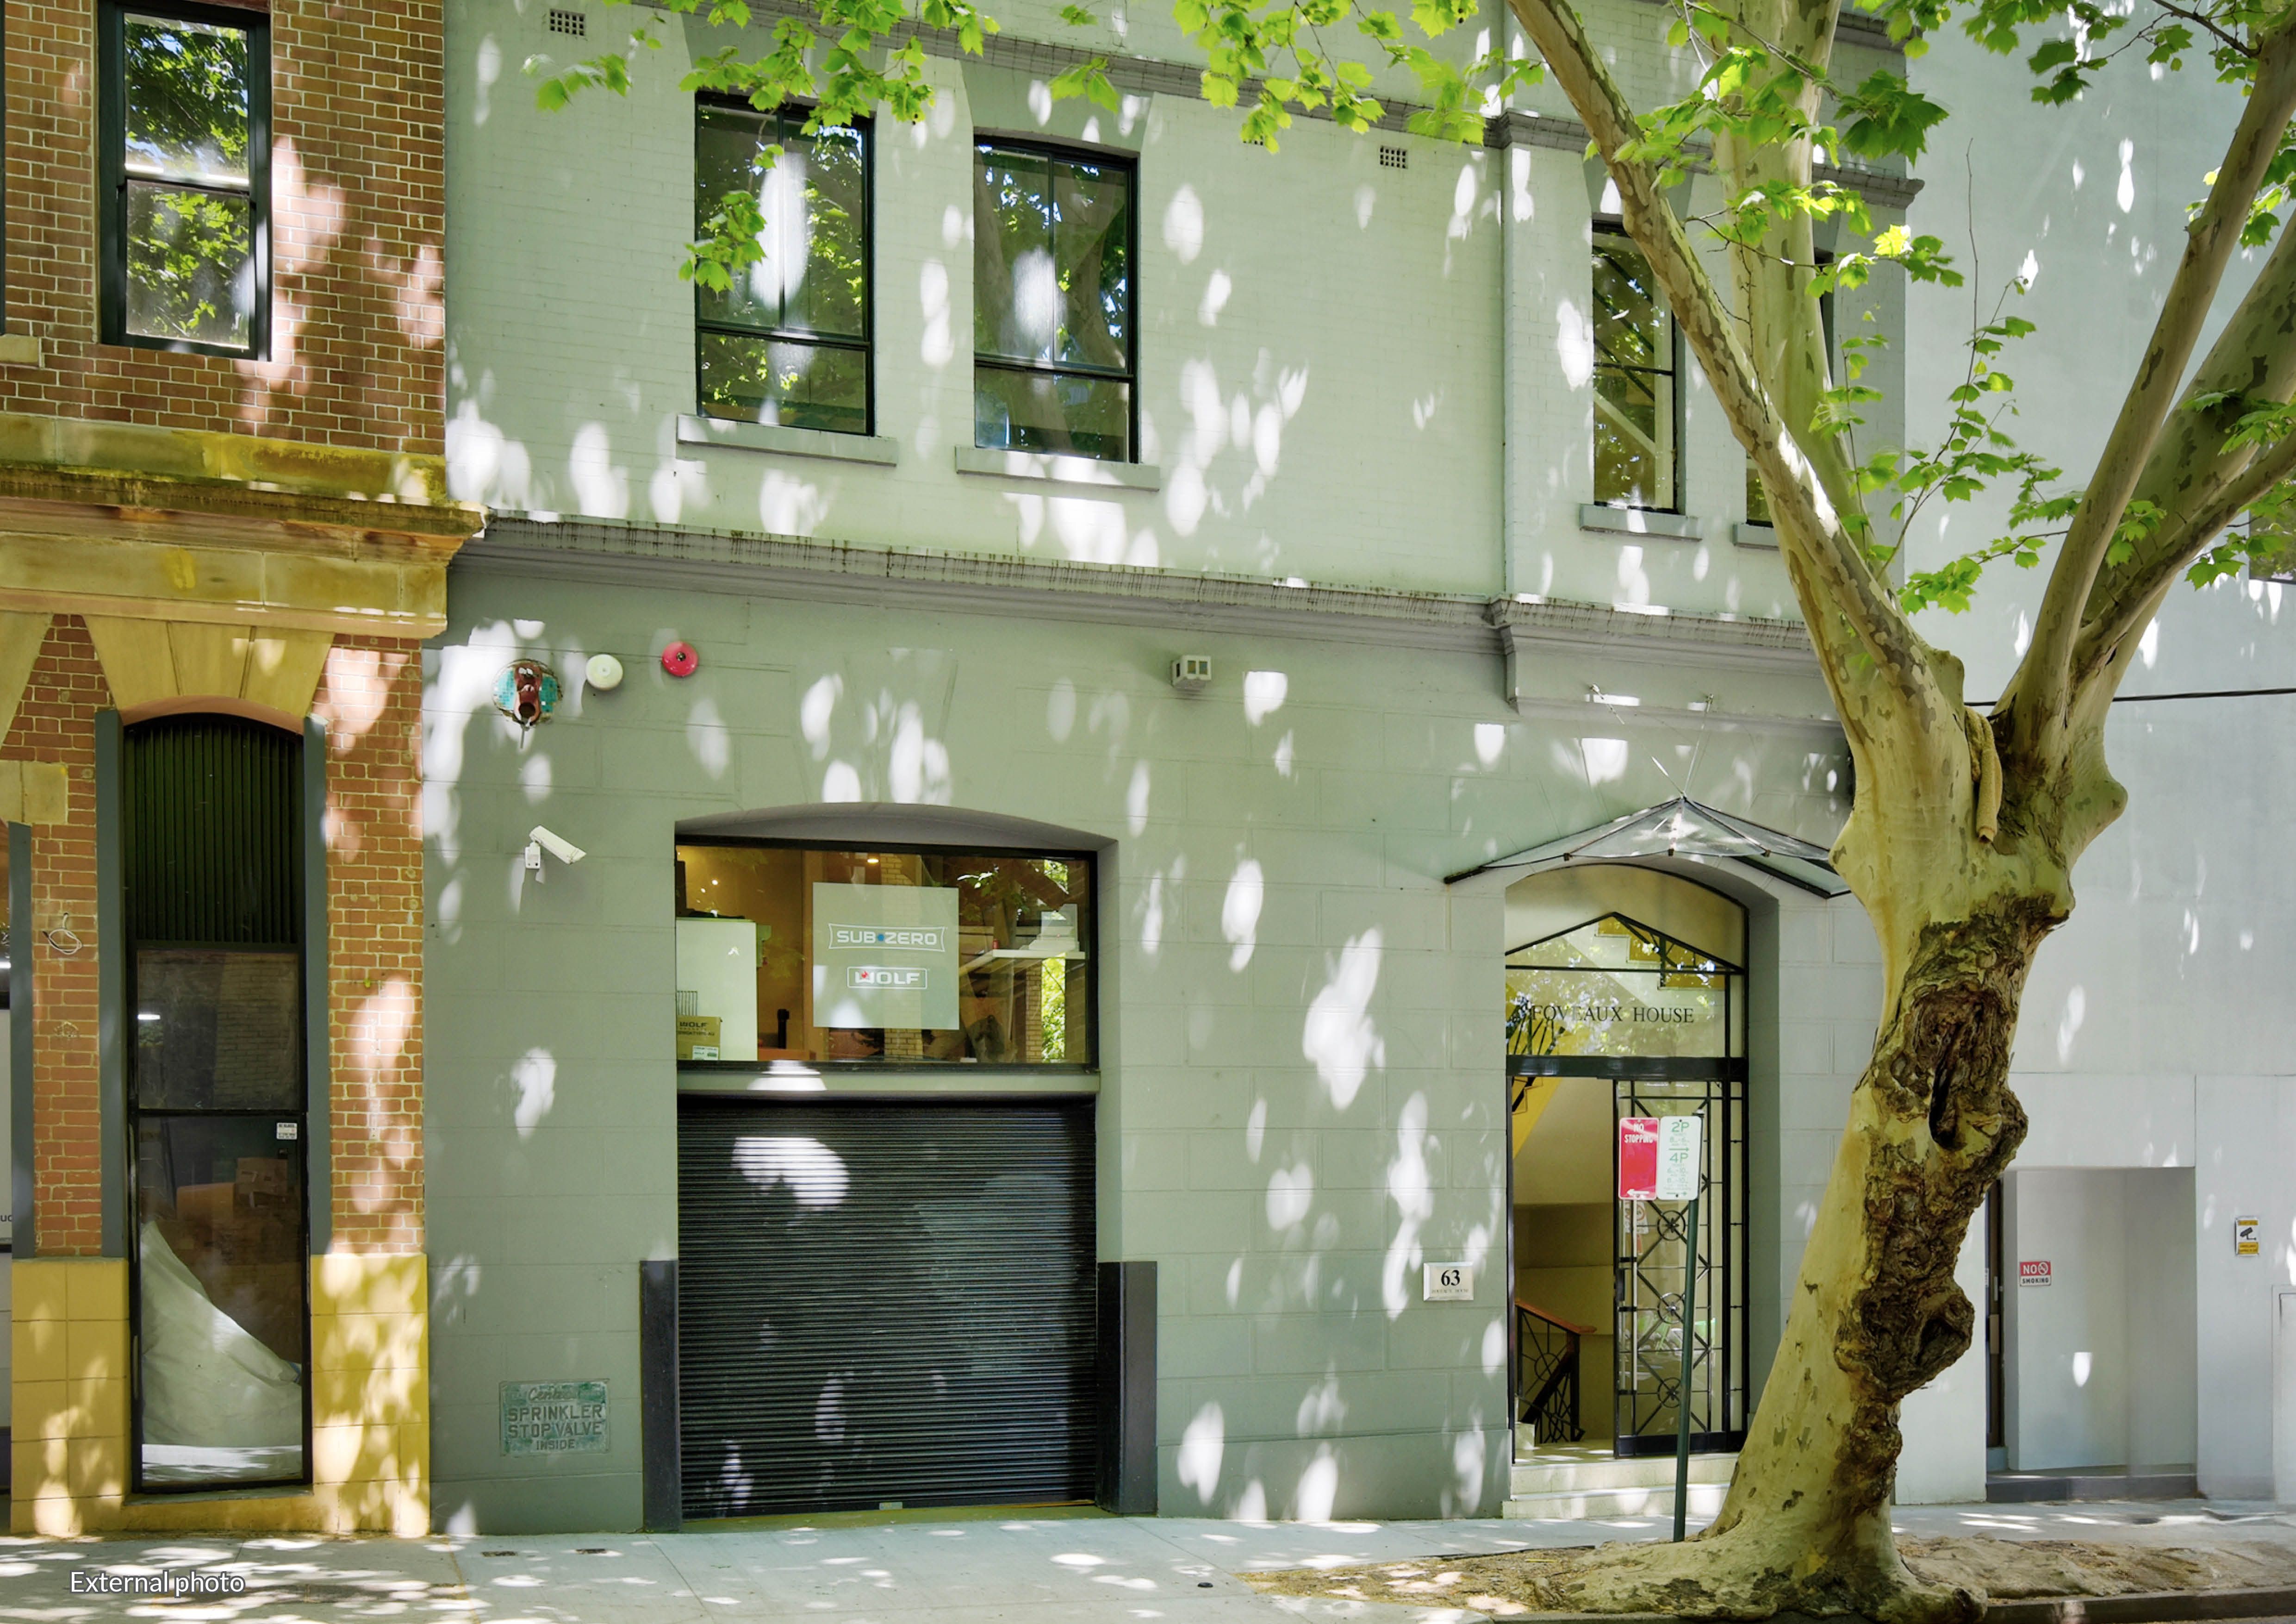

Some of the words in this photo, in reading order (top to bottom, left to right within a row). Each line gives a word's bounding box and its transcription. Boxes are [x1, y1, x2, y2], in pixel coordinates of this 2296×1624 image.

[855, 971, 920, 985] WOLF
[1633, 1007, 1694, 1023] HOUSE
[1633, 1123, 1644, 1132] NO
[1671, 1122, 1689, 1132] 2P
[1624, 1134, 1654, 1143] STOPPING
[1669, 1152, 1689, 1163] 4P
[2023, 1264, 2037, 1274] NO
[1441, 1270, 1460, 1286] 63
[508, 1404, 602, 1422] SPRINKLER
[508, 1424, 551, 1438] STOP
[556, 1421, 602, 1436] VALVE
[536, 1439, 575, 1450] INSIDE
